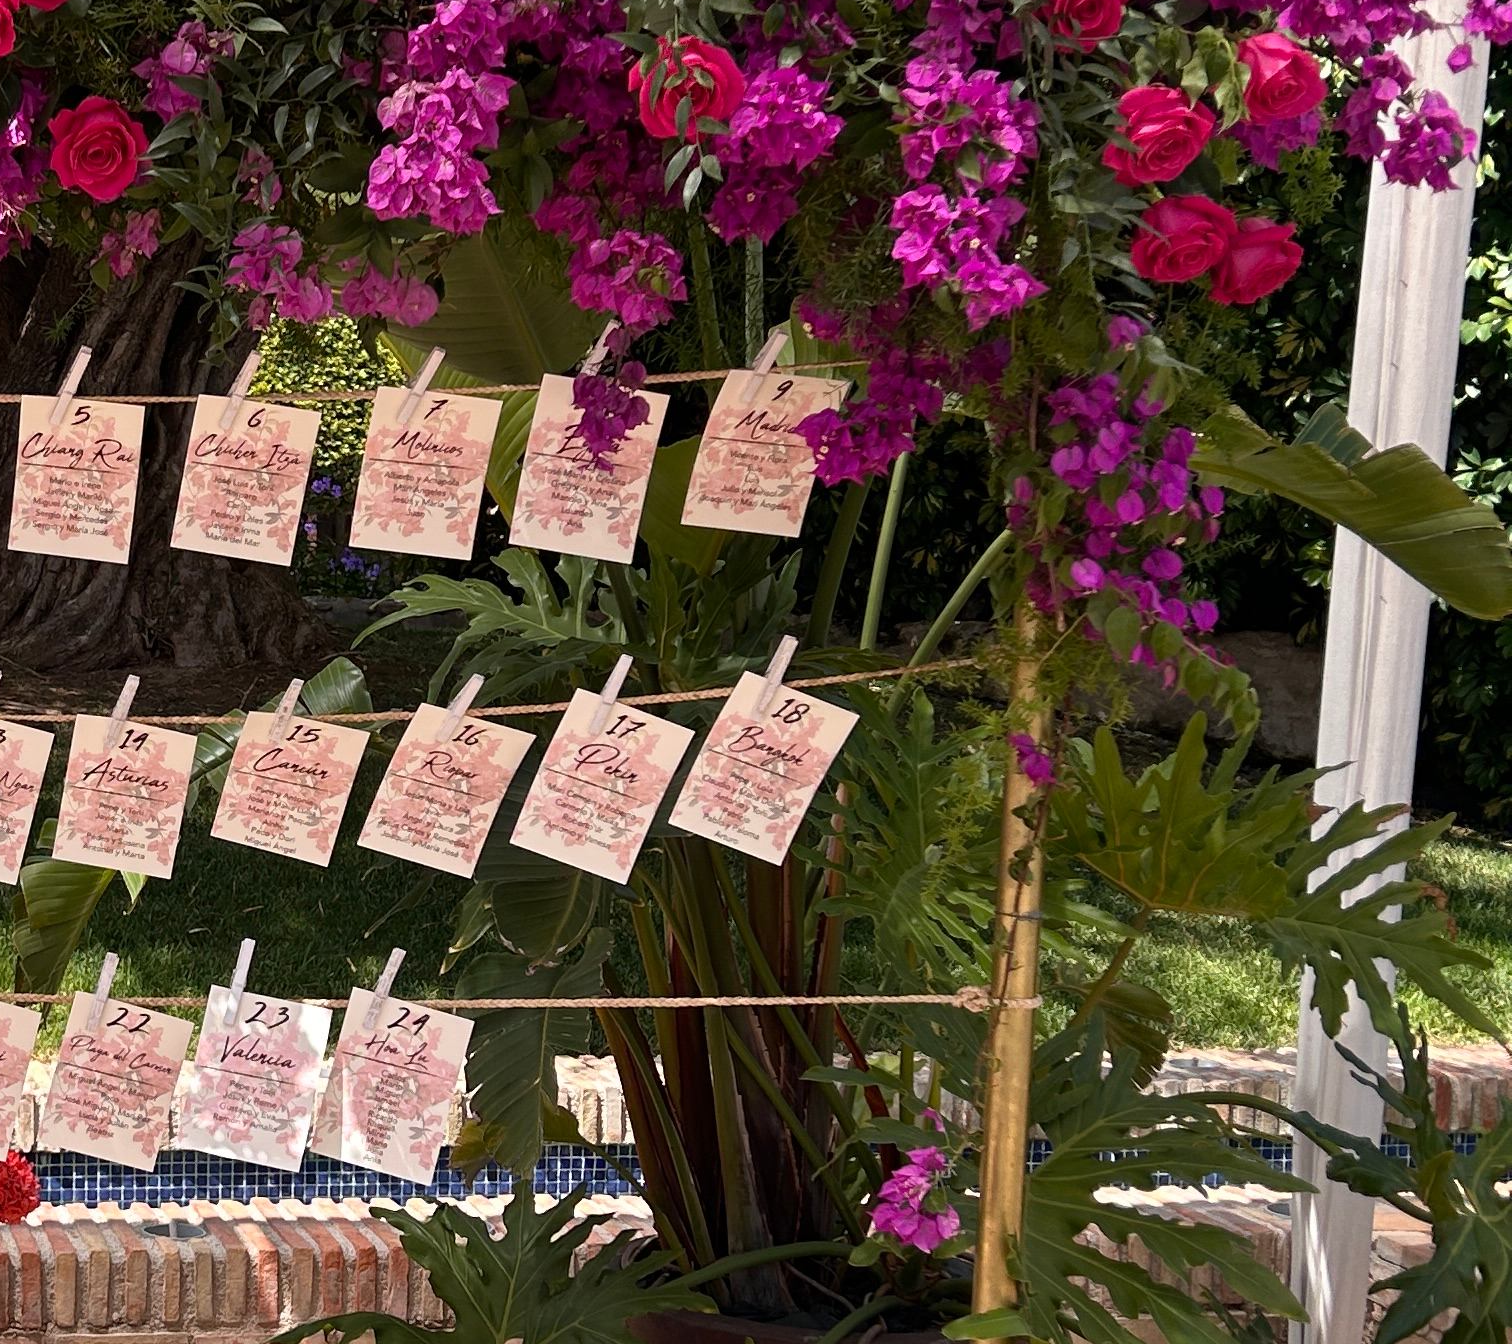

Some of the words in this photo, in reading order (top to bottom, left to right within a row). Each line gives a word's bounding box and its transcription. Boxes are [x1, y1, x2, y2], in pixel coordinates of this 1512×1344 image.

[771, 380, 793, 401] 9
[71, 406, 91, 425] 5
[248, 408, 266, 427] 6
[424, 399, 449, 420] 7
[22, 432, 84, 469] Chiang
[92, 438, 135, 470] Rai
[392, 430, 463, 459] Molinicos
[33, 497, 60, 507] Miguel
[771, 698, 810, 724] 18
[286, 725, 322, 743] 15
[452, 724, 487, 746] 16
[606, 715, 647, 739] 17
[728, 726, 810, 767] Bangkok
[82, 758, 169, 792] Asturias
[253, 748, 330, 779] Cancún
[106, 1007, 151, 1034] 22
[245, 1001, 290, 1030] 23
[71, 1035, 109, 1062] Playa
[129, 1053, 172, 1075] Carmen
[220, 1034, 296, 1069] Valencia
